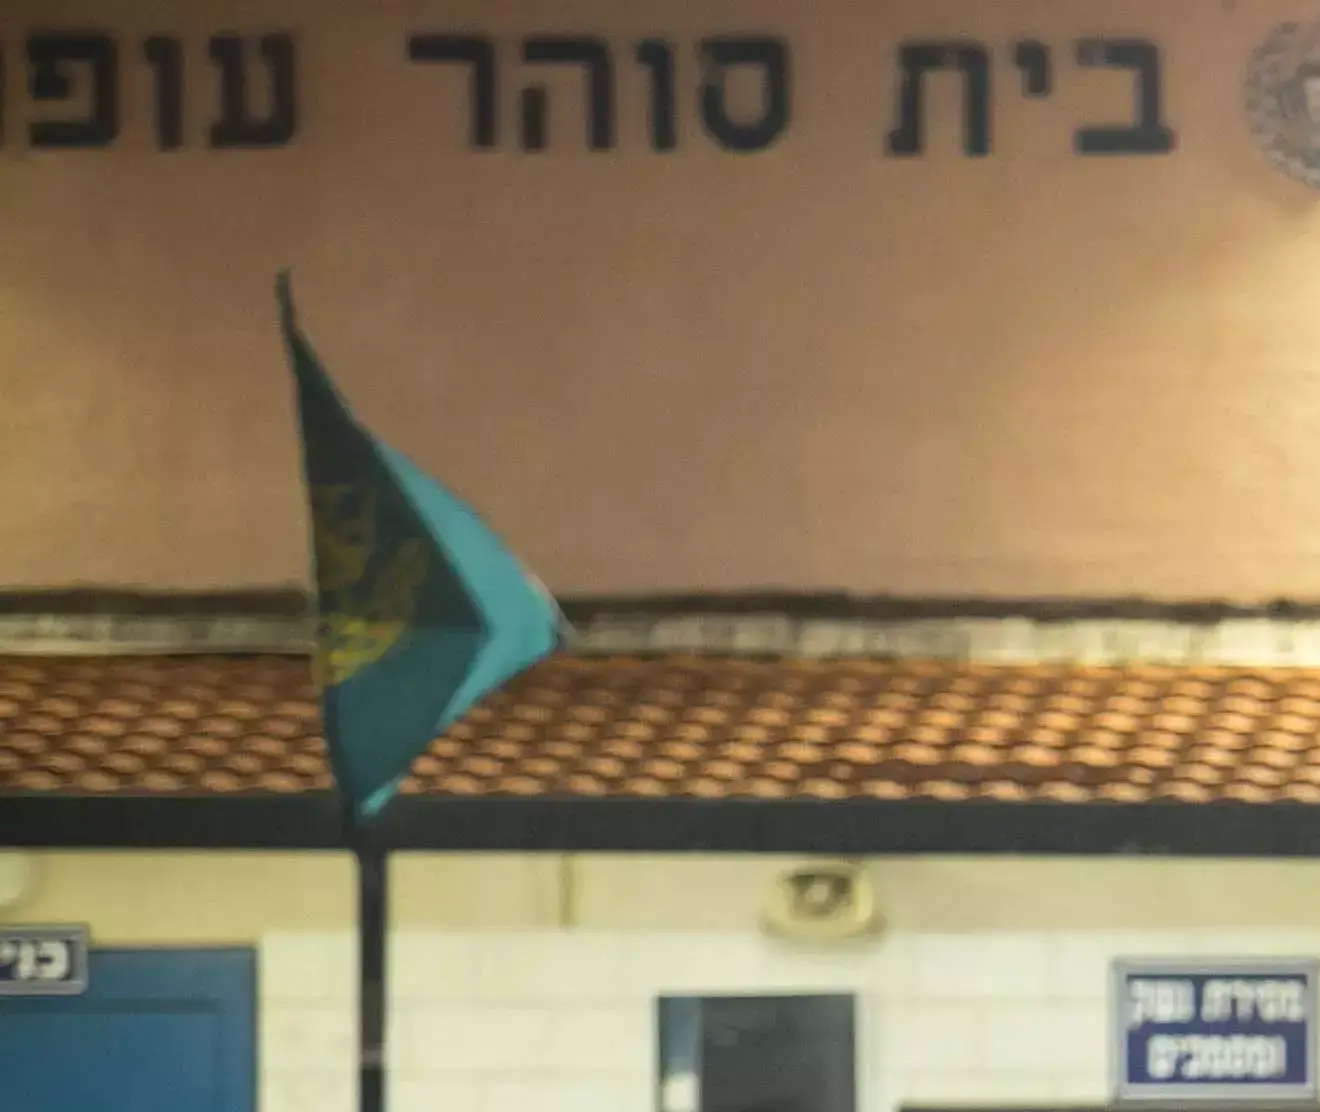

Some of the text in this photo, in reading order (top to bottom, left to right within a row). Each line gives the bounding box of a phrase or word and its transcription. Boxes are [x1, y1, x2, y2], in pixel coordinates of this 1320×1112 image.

[0, 28, 1176, 157] בית סוהר עופ
